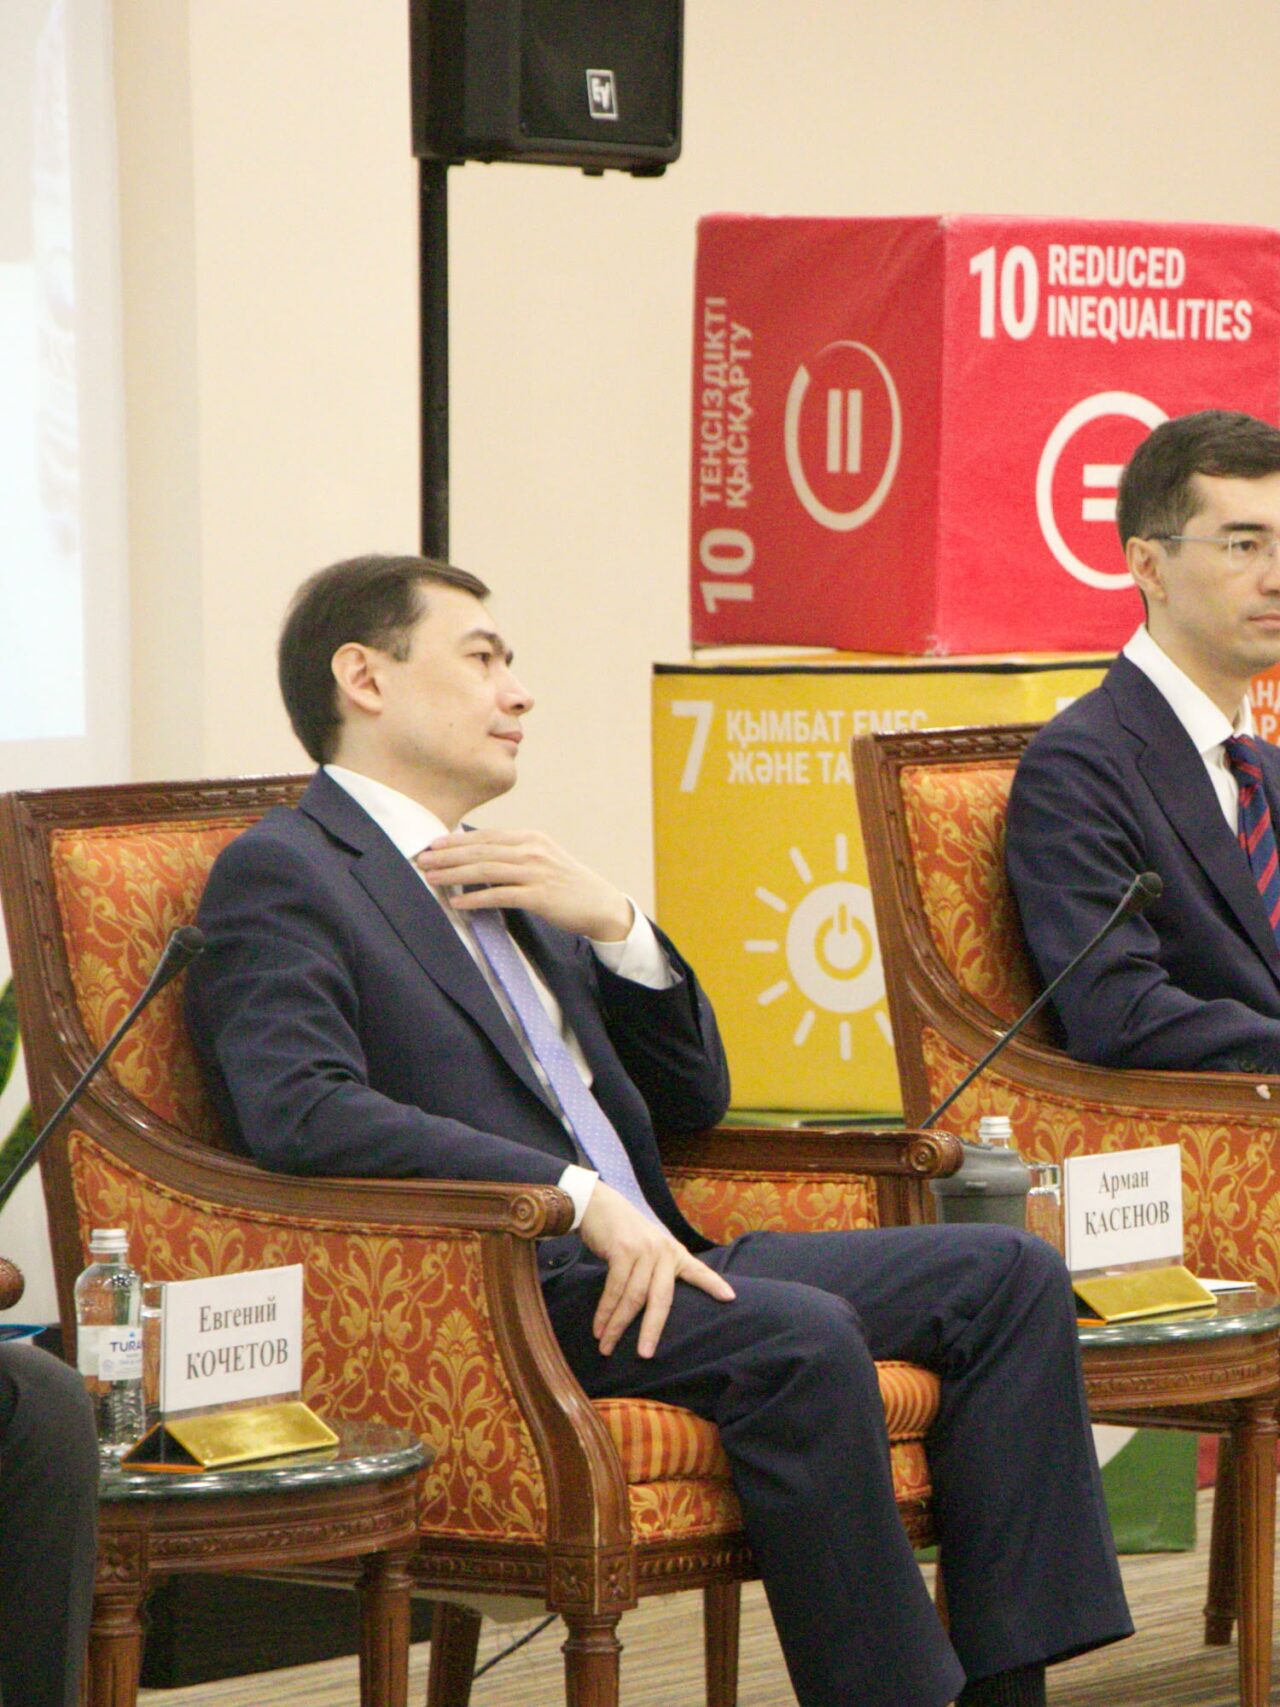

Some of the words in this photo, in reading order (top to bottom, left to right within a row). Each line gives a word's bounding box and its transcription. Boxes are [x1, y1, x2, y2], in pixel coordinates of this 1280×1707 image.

[1048, 244, 1185, 289] REDUCED
[969, 245, 1040, 340] 10
[1048, 296, 1253, 342] INEQUALITIES
[726, 322, 754, 508] ҚЫСҚАРТУ
[700, 528, 755, 613] 10
[671, 700, 714, 793] 7
[726, 709, 845, 748] ҚЫМБАТ
[727, 752, 810, 785] ЖӘНЕ
[1098, 1169, 1150, 1200] Арман
[198, 1296, 278, 1334] Евгений
[186, 1338, 289, 1380] КОЧЕТОВ
